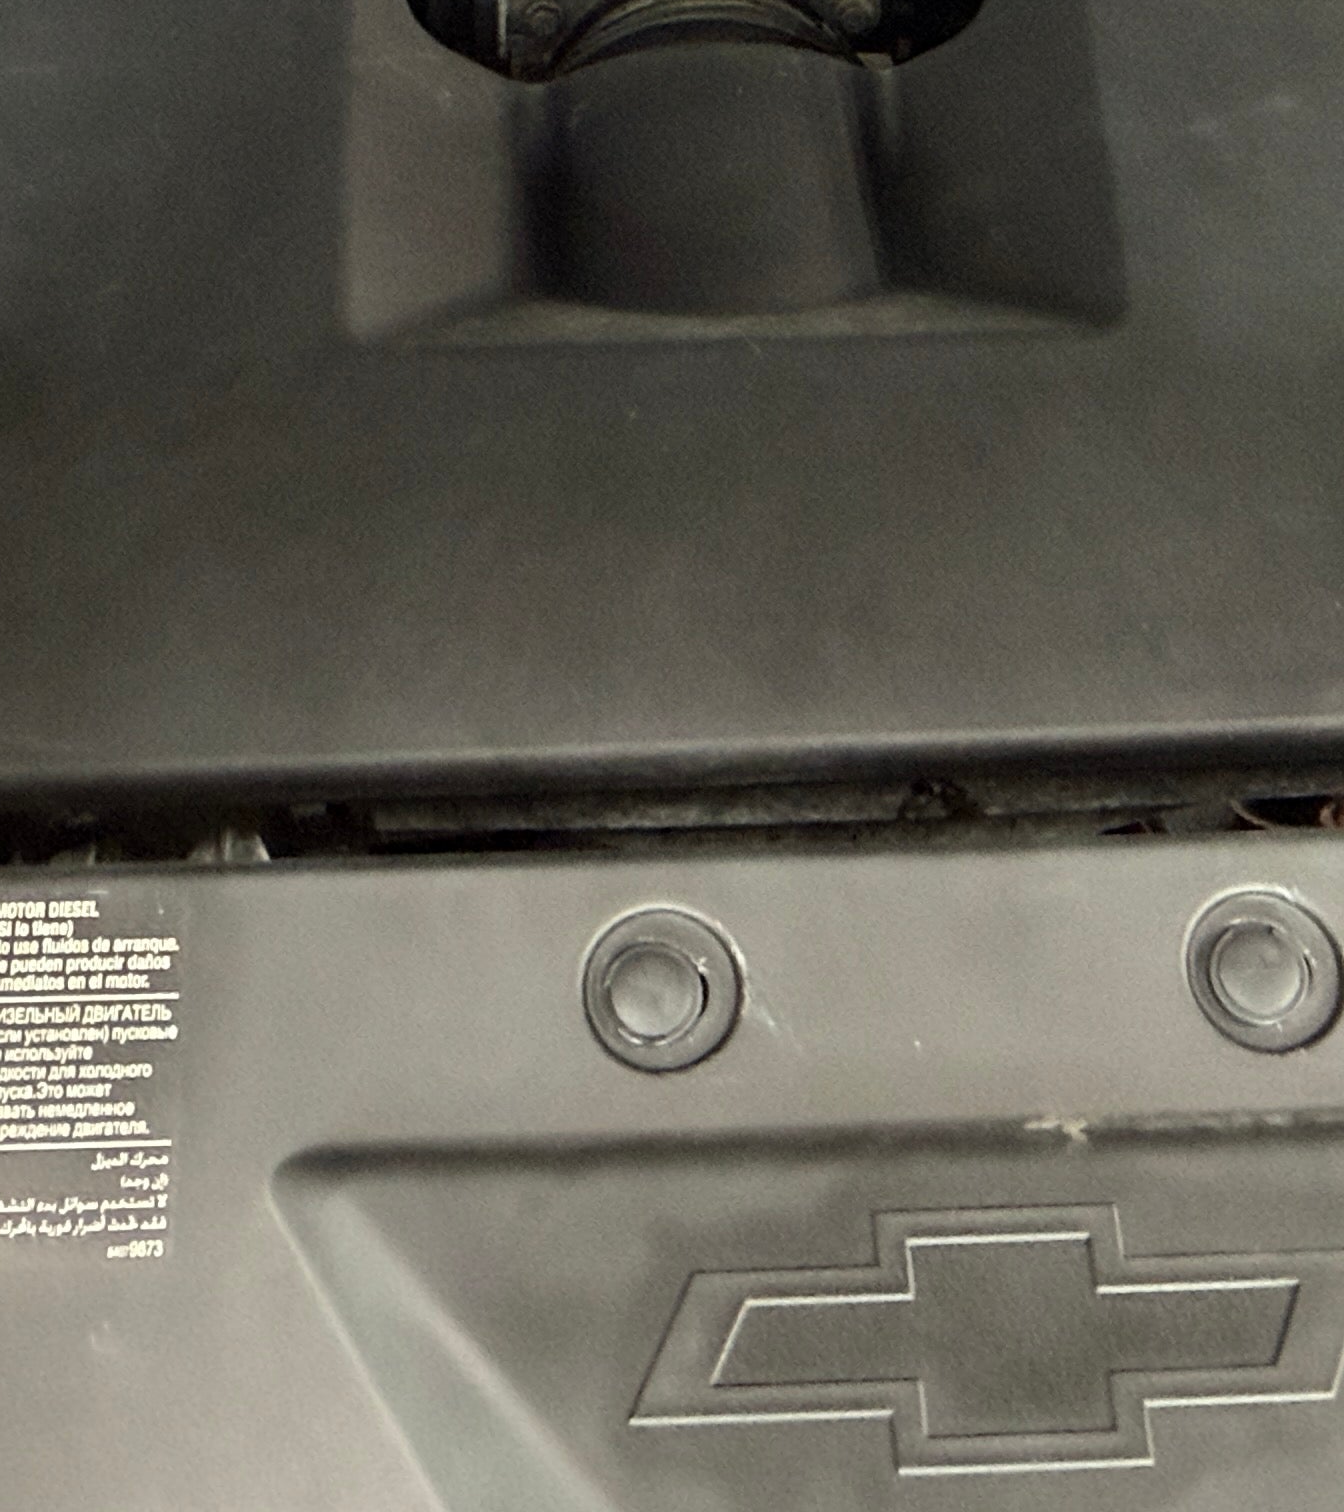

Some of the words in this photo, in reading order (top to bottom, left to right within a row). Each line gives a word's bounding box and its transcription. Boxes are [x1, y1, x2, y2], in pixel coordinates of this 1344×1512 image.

[49, 900, 99, 918] DIESEL
[15, 921, 29, 937] lo
[32, 920, 74, 938] tiene)
[13, 940, 39, 955] use
[43, 938, 89, 954] fluidos
[92, 936, 110, 953] de
[113, 937, 180, 956] arranque.
[10, 956, 62, 976] pueden
[66, 955, 125, 975] producir
[128, 954, 171, 970] daños
[68, 976, 86, 990] en
[89, 974, 103, 989] el
[106, 973, 150, 989] motor.
[82, 1004, 172, 1024] ДВИГАТЕЛЬ
[24, 1025, 109, 1046] установлен)
[5, 1045, 93, 1064] используйте
[48, 1065, 76, 1080] для
[78, 1063, 153, 1080] холодного
